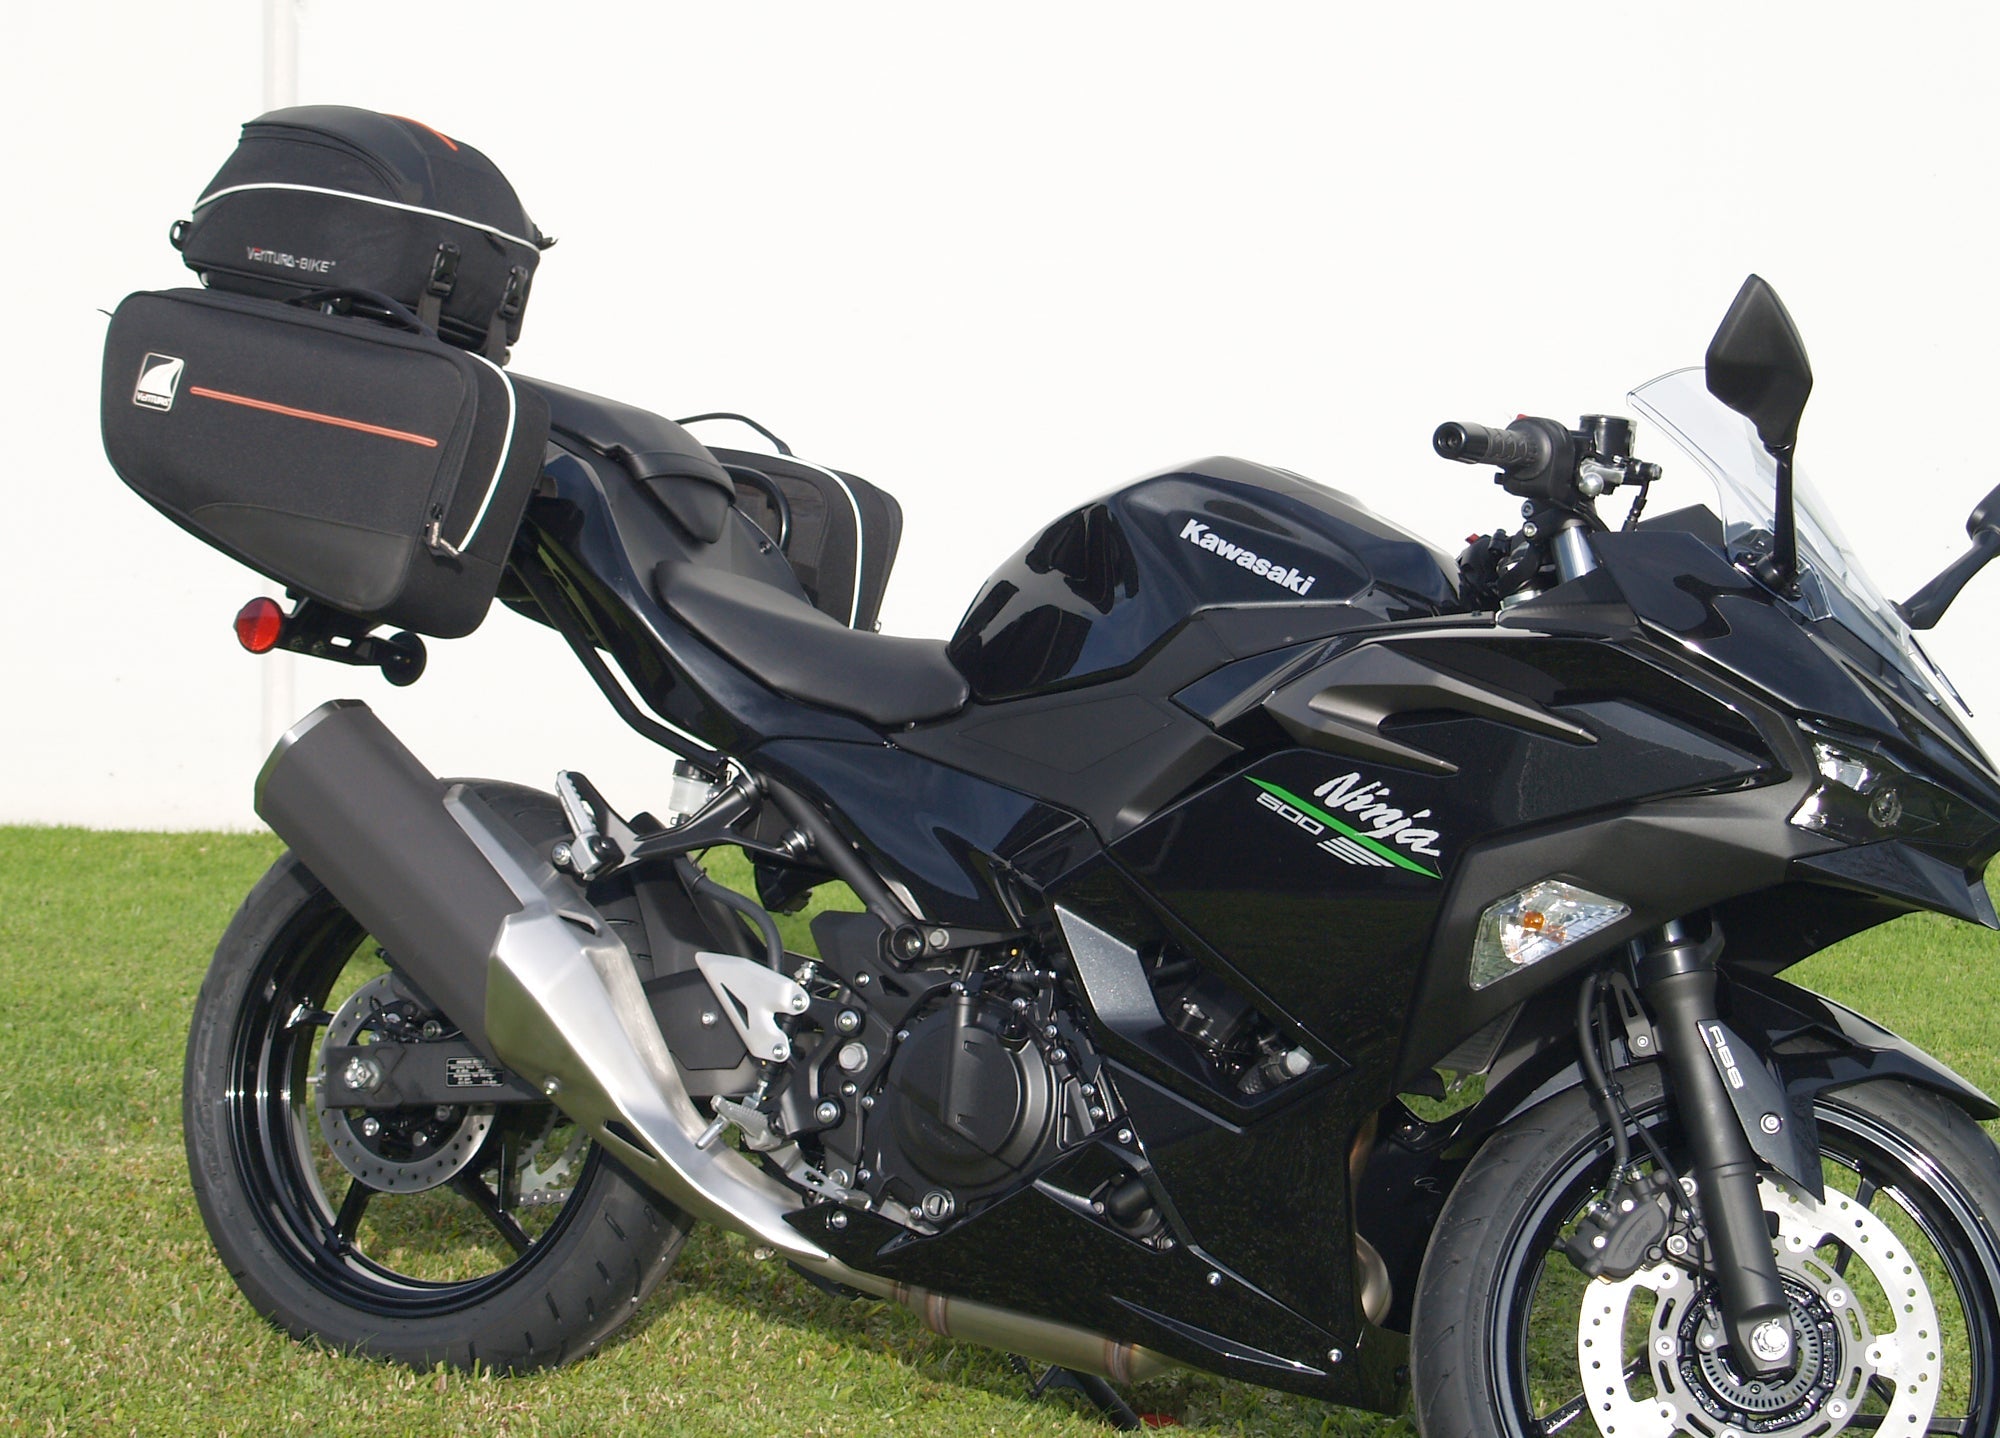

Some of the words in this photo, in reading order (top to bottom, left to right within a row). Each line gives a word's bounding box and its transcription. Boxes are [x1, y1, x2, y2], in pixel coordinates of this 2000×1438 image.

[1179, 518, 1316, 596] Kawasaki
[1255, 791, 1326, 836] 500
[1313, 772, 1441, 857] Ninja
[1708, 1025, 1744, 1090] ABS
